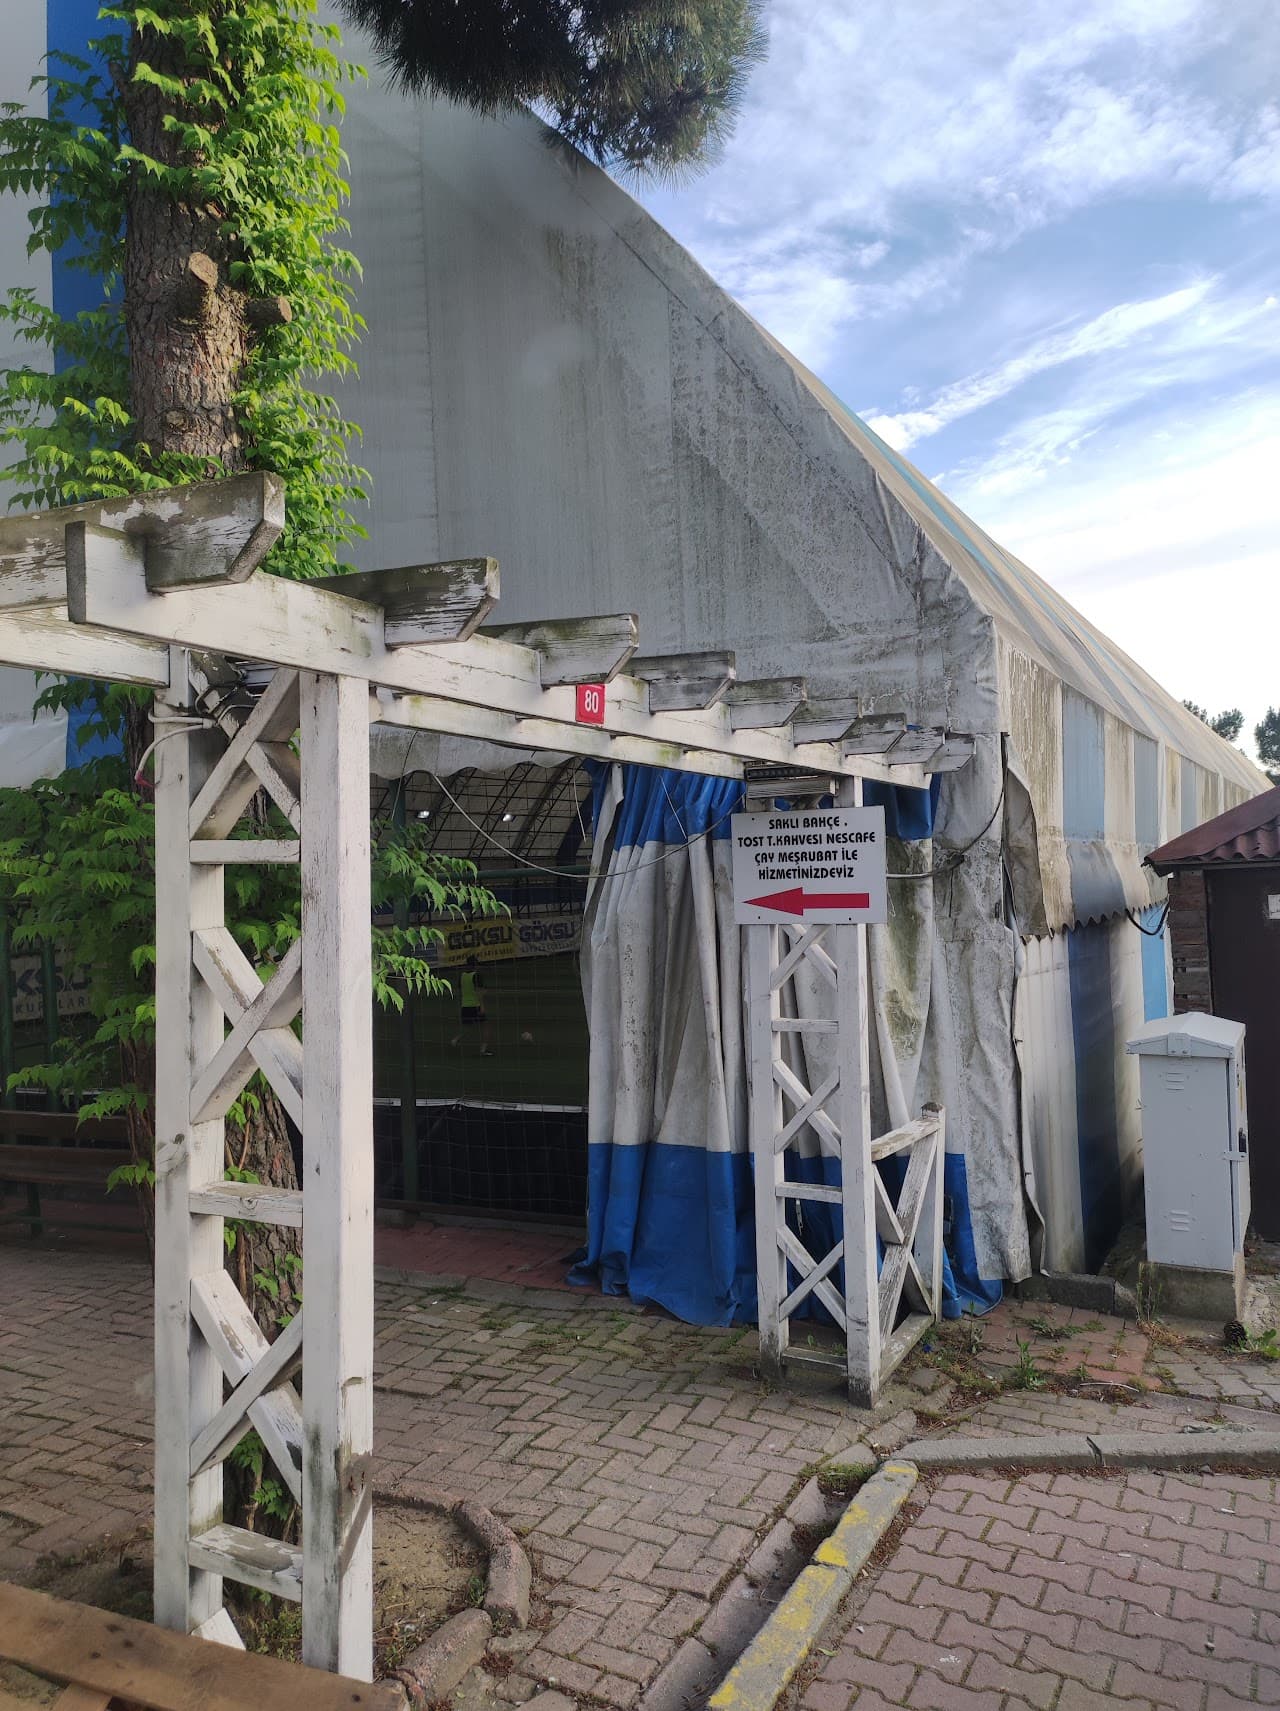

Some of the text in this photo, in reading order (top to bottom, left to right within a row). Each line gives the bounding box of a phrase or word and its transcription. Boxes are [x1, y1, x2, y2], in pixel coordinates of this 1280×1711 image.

[585, 690, 599, 713] 80
[768, 816, 840, 830] SAKLI BAHÇE
[738, 836, 764, 848] TOST
[826, 831, 876, 844] NESCAFE
[754, 847, 858, 866] ÇAY MEŞRUBAT İLE
[758, 864, 855, 880] HİZMETİNİZDEYİZ
[447, 924, 513, 950] GÖKSU
[519, 920, 576, 943] GÖKSU
